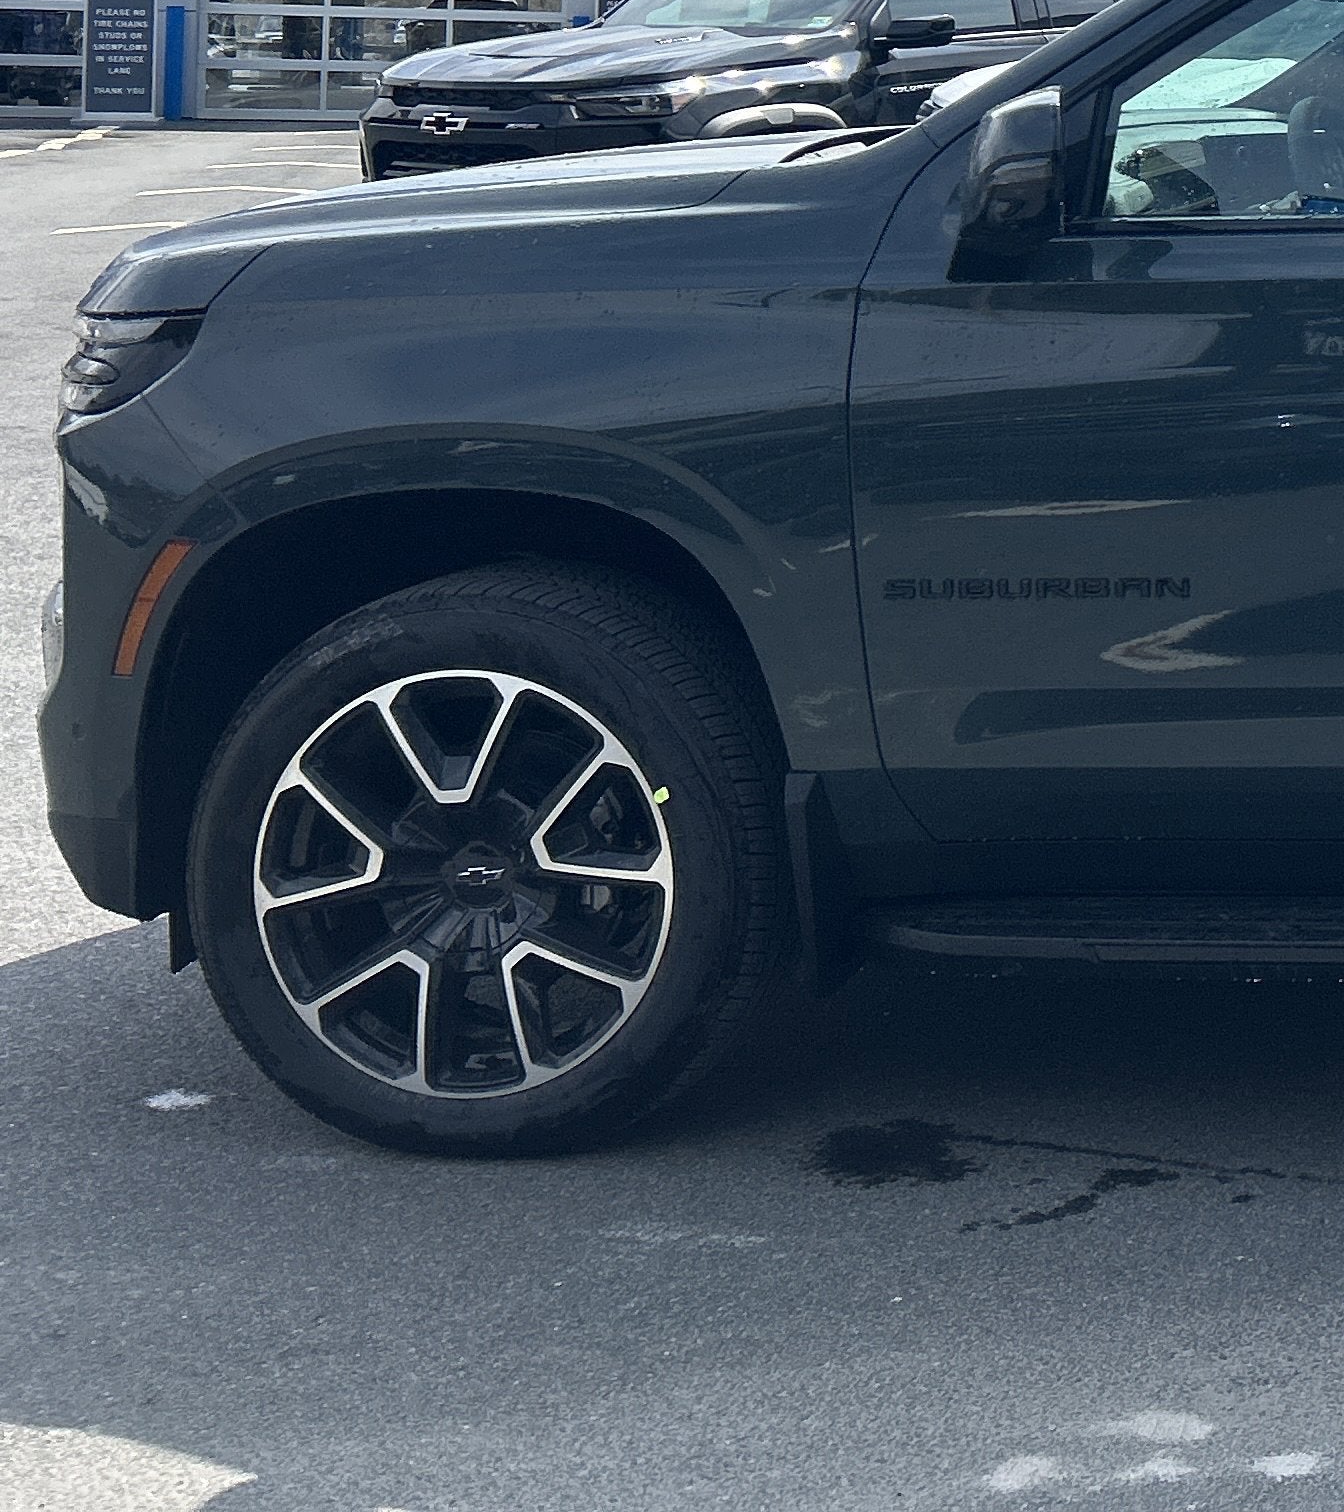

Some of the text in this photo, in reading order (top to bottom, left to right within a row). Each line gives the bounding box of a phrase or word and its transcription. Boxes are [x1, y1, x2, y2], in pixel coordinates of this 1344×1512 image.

[96, 8, 130, 16] PLEASE
[116, 20, 148, 28] CHAINS
[883, 577, 1192, 600] SUBURBAN
